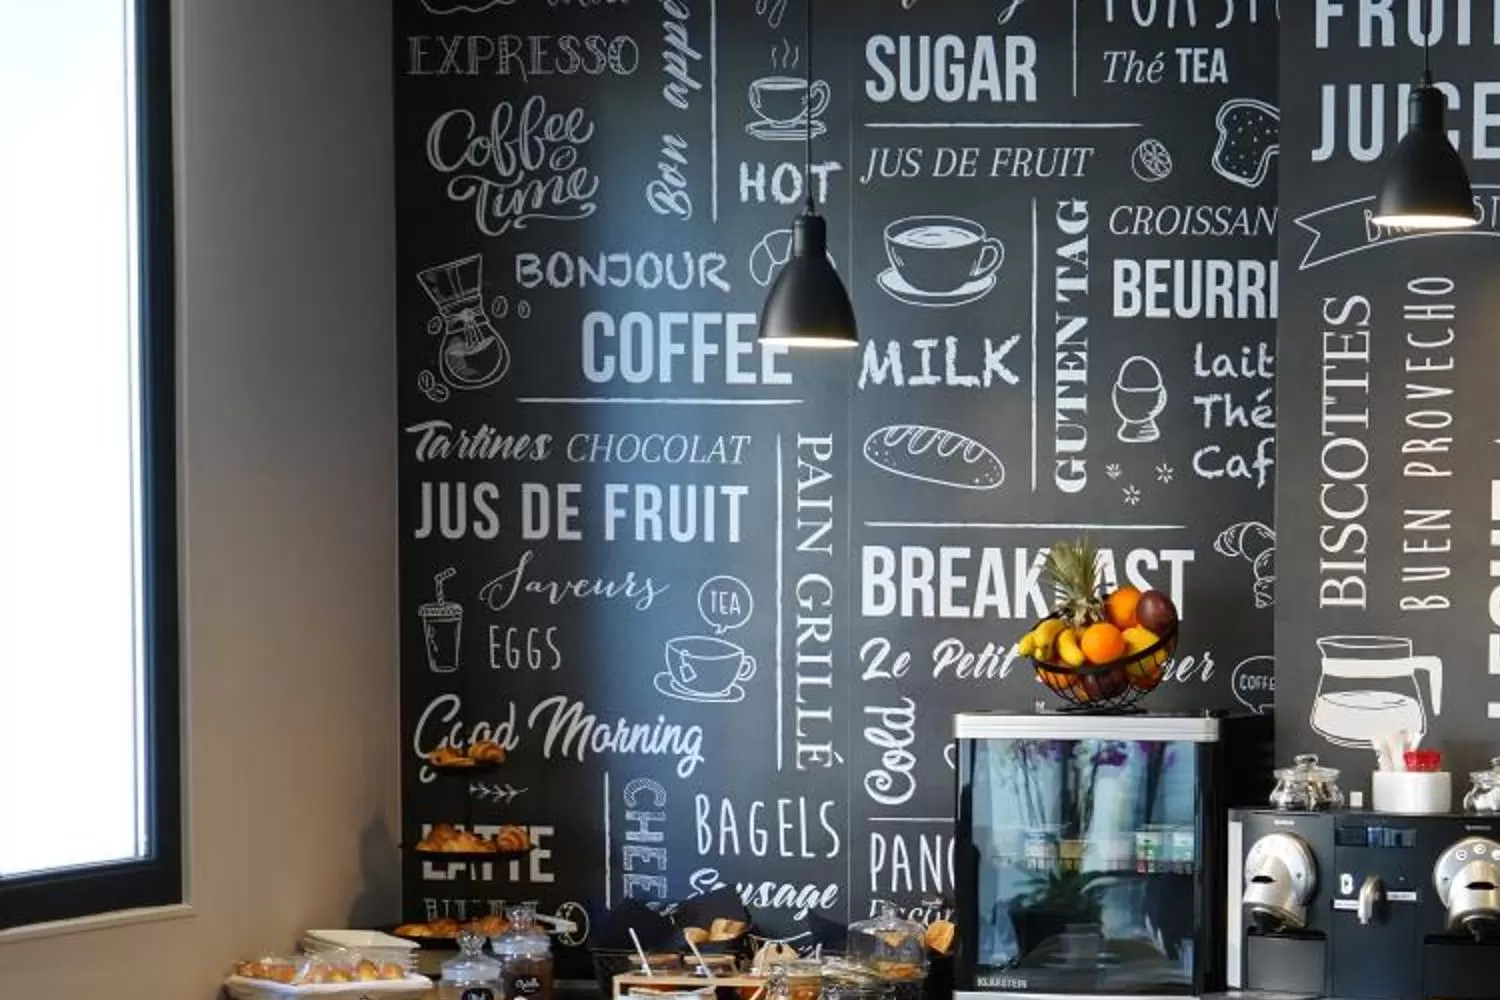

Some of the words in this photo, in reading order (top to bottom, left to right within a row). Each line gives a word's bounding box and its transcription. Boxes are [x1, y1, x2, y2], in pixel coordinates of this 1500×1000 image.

[406, 34, 640, 83] EXPRESSO
[866, 35, 1036, 102] SUGAR
[1104, 50, 1164, 83] Thé
[1176, 48, 1228, 83] TEA
[427, 96, 596, 176] Coffee
[860, 148, 922, 184] JUS
[933, 148, 979, 176] DE
[990, 148, 1094, 176] FRUIT
[447, 167, 598, 236] Time
[646, 135, 692, 221] Bon
[740, 162, 841, 204] HOT
[517, 250, 730, 292] BONJOUR
[1056, 200, 1088, 302] TAG
[1113, 259, 1278, 318] BEURR
[858, 335, 1020, 390] MILK
[1402, 278, 1455, 476] PROVECHO
[1055, 313, 1087, 493] GUTEN
[1194, 389, 1277, 428] Thé
[406, 420, 552, 461] Tartines
[568, 433, 751, 464] CHOCOLAT
[1320, 296, 1370, 609] BISCOTTES
[415, 482, 499, 539] JUS
[522, 484, 582, 540] DE
[606, 484, 749, 543] FRUIT
[796, 433, 832, 556] PAIN
[480, 550, 669, 610] Saveurs
[861, 545, 1194, 620] BREAKST
[1400, 510, 1451, 610] BUEN
[710, 591, 740, 616] TEA
[490, 625, 561, 670] EGGS
[796, 574, 843, 769] GRILLÉ
[933, 638, 1018, 678] Petit
[528, 695, 704, 778] Morning
[864, 697, 916, 804] Cold
[623, 778, 667, 899] CHEE
[696, 794, 840, 858] BAGELS
[688, 868, 838, 920] Susage
